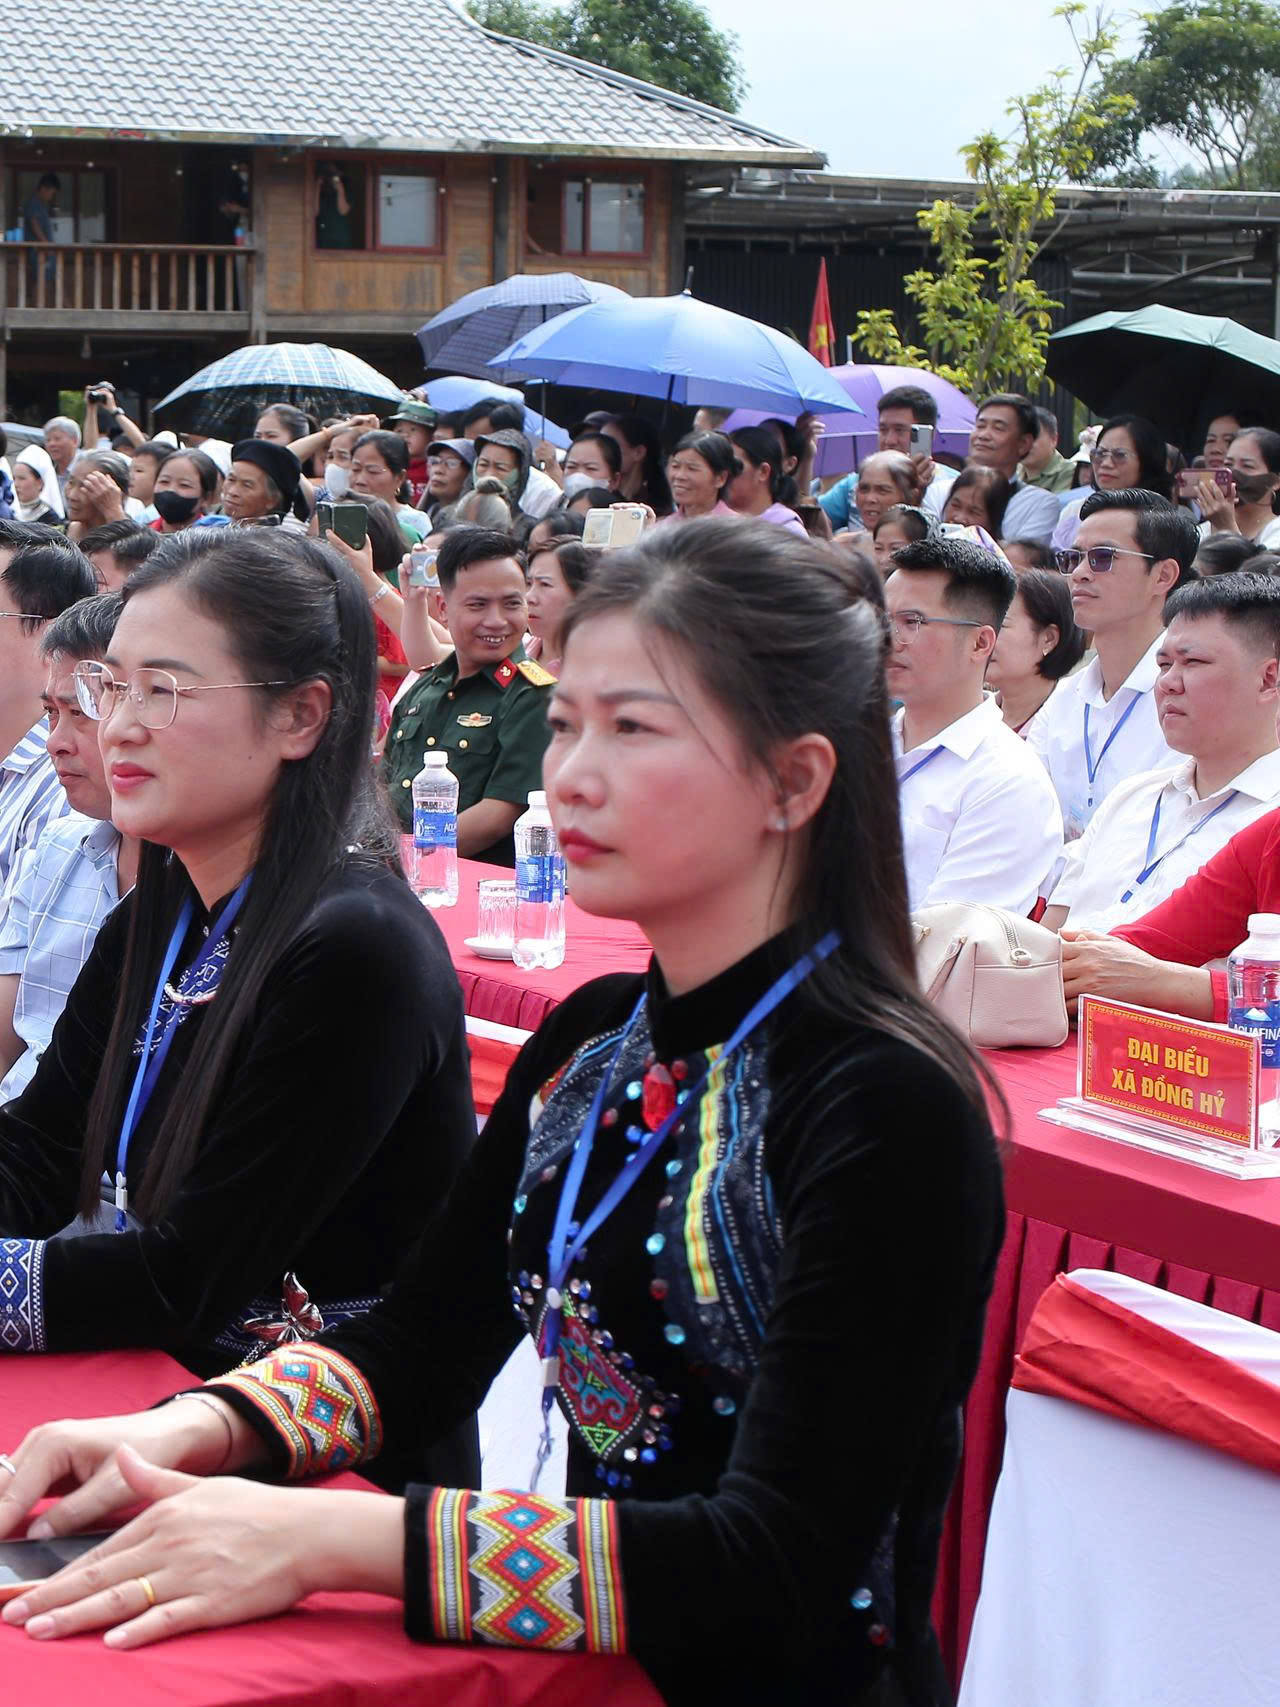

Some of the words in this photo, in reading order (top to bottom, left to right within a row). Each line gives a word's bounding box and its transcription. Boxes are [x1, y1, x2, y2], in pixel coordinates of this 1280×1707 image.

[1127, 1037, 1159, 1067] ĐẠI
[1164, 1045, 1209, 1078] BIỂU
[1111, 1067, 1137, 1094] XÃ
